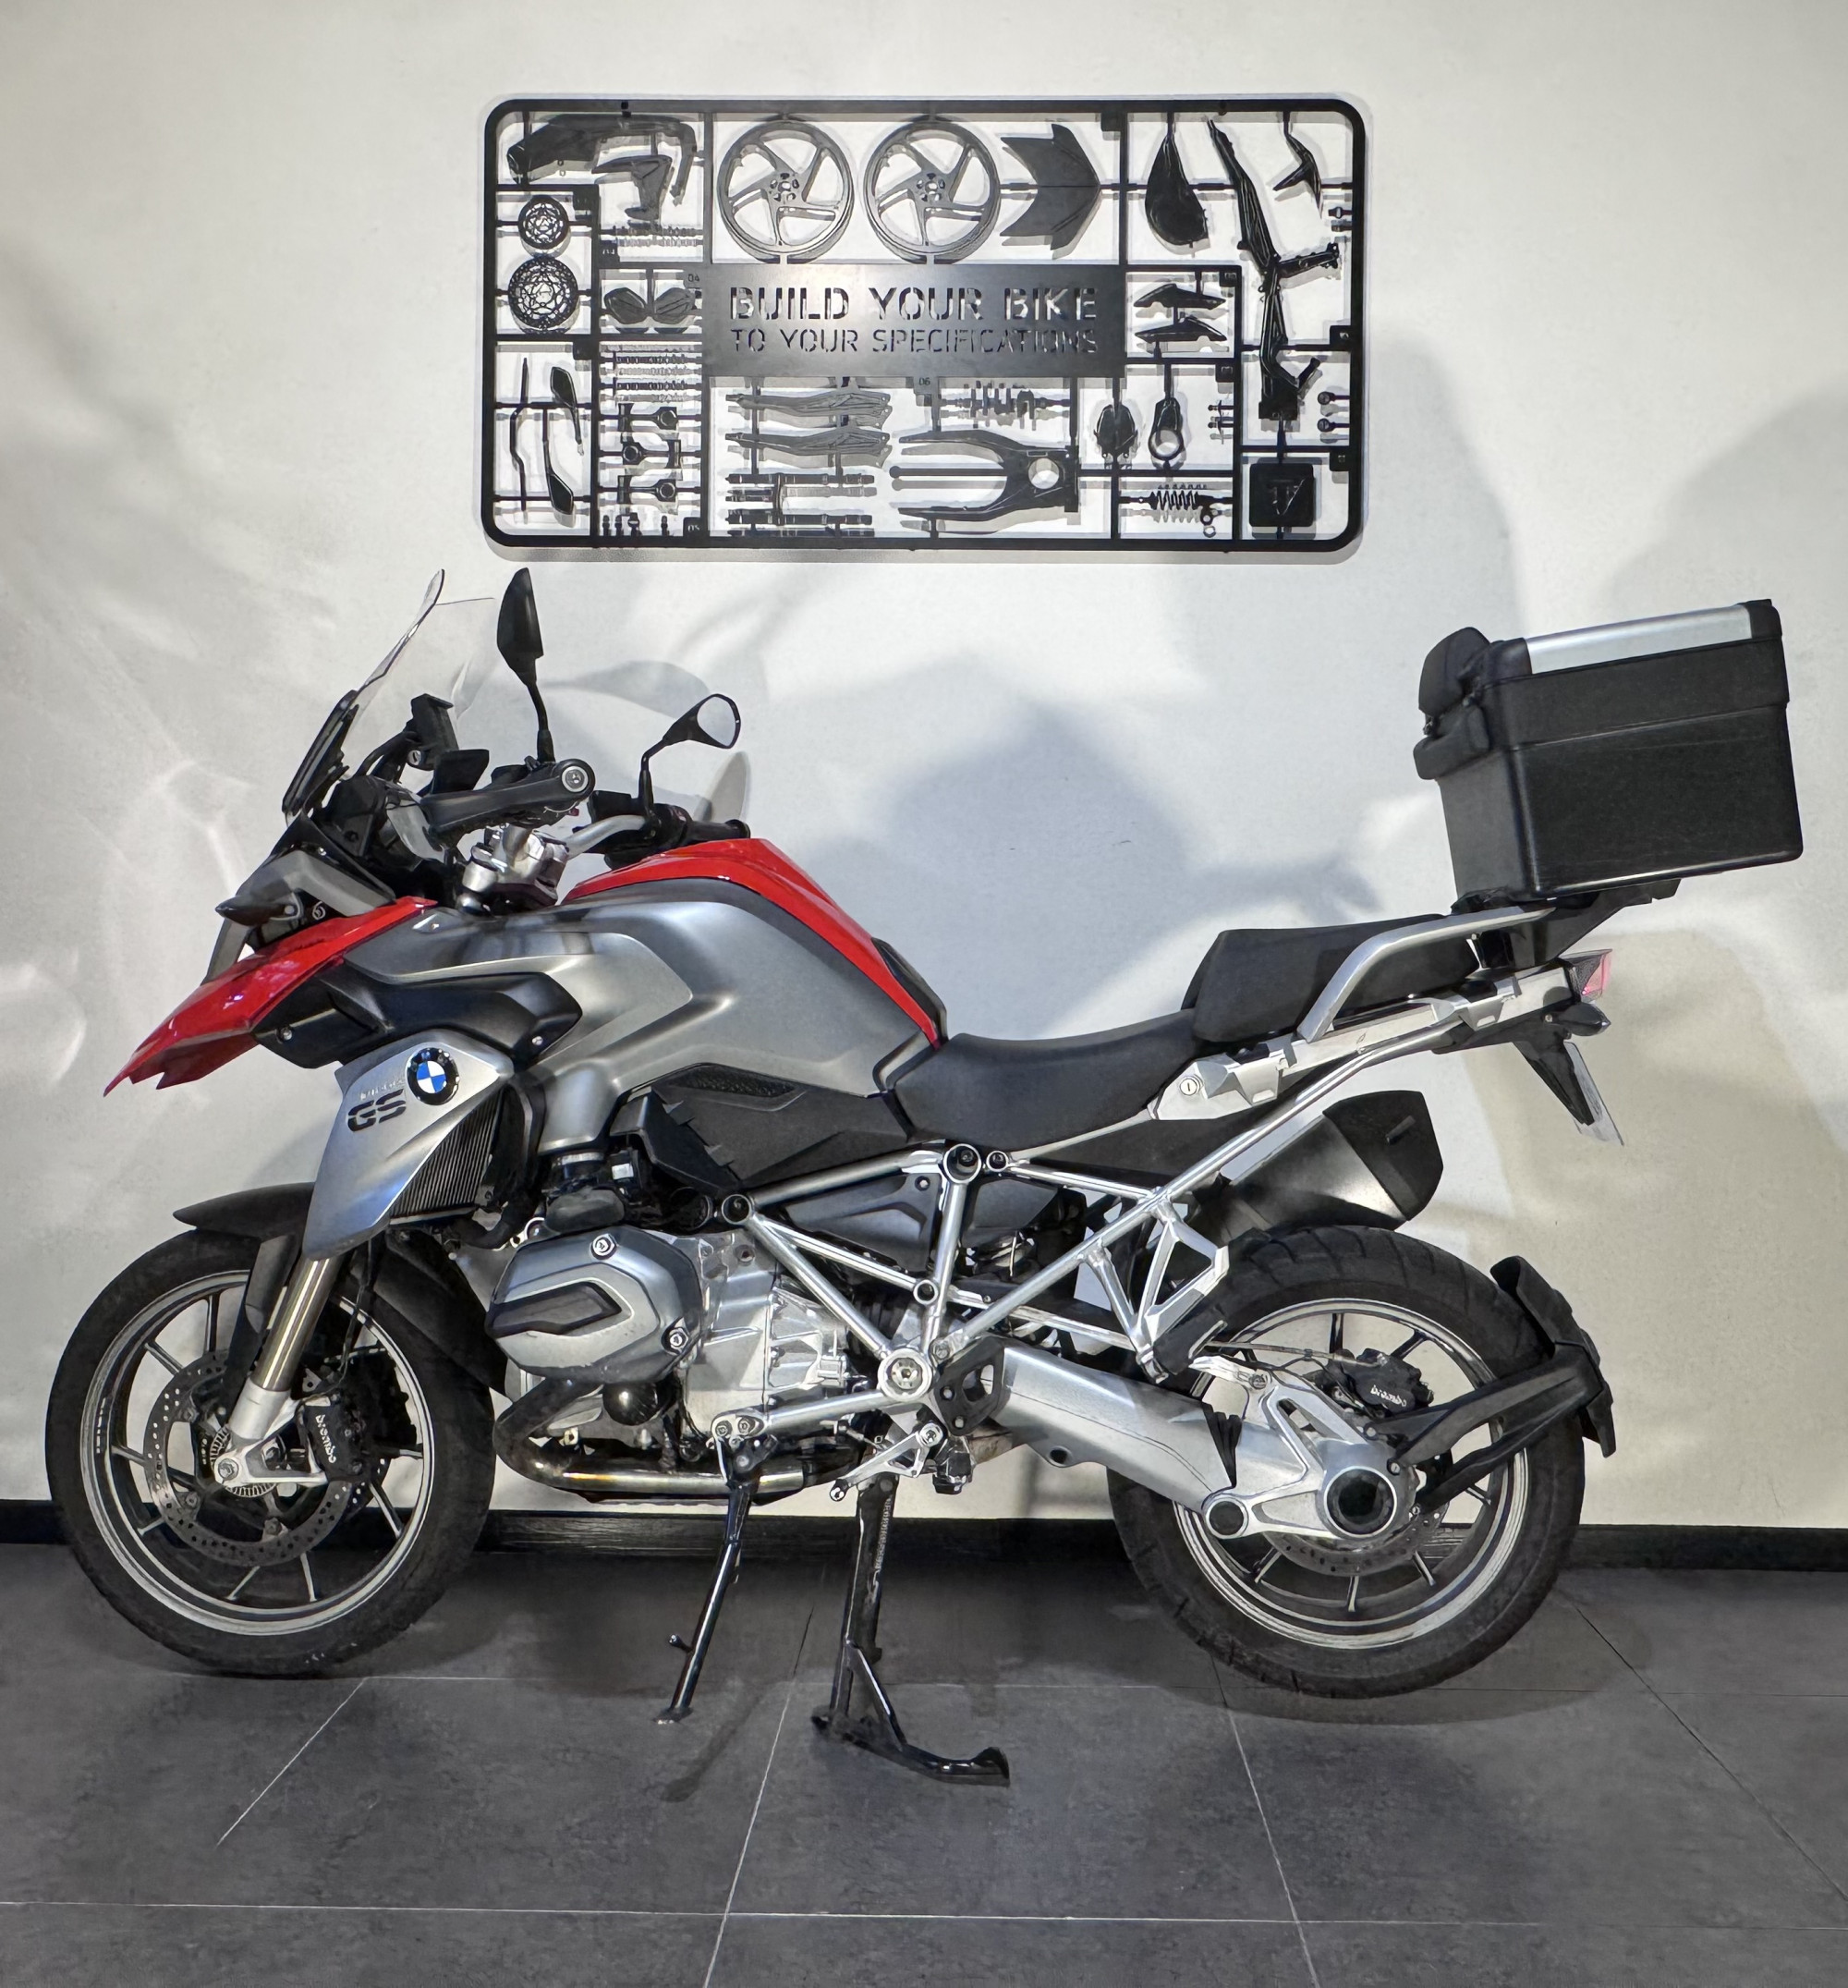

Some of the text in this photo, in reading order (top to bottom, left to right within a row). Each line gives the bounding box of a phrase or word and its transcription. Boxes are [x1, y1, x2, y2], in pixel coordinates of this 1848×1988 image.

[730, 287, 1098, 321] BUILD YOUR BIKE
[731, 328, 1099, 353] TO YOUR SPECIFICATIONS
[347, 1089, 407, 1132] GS
